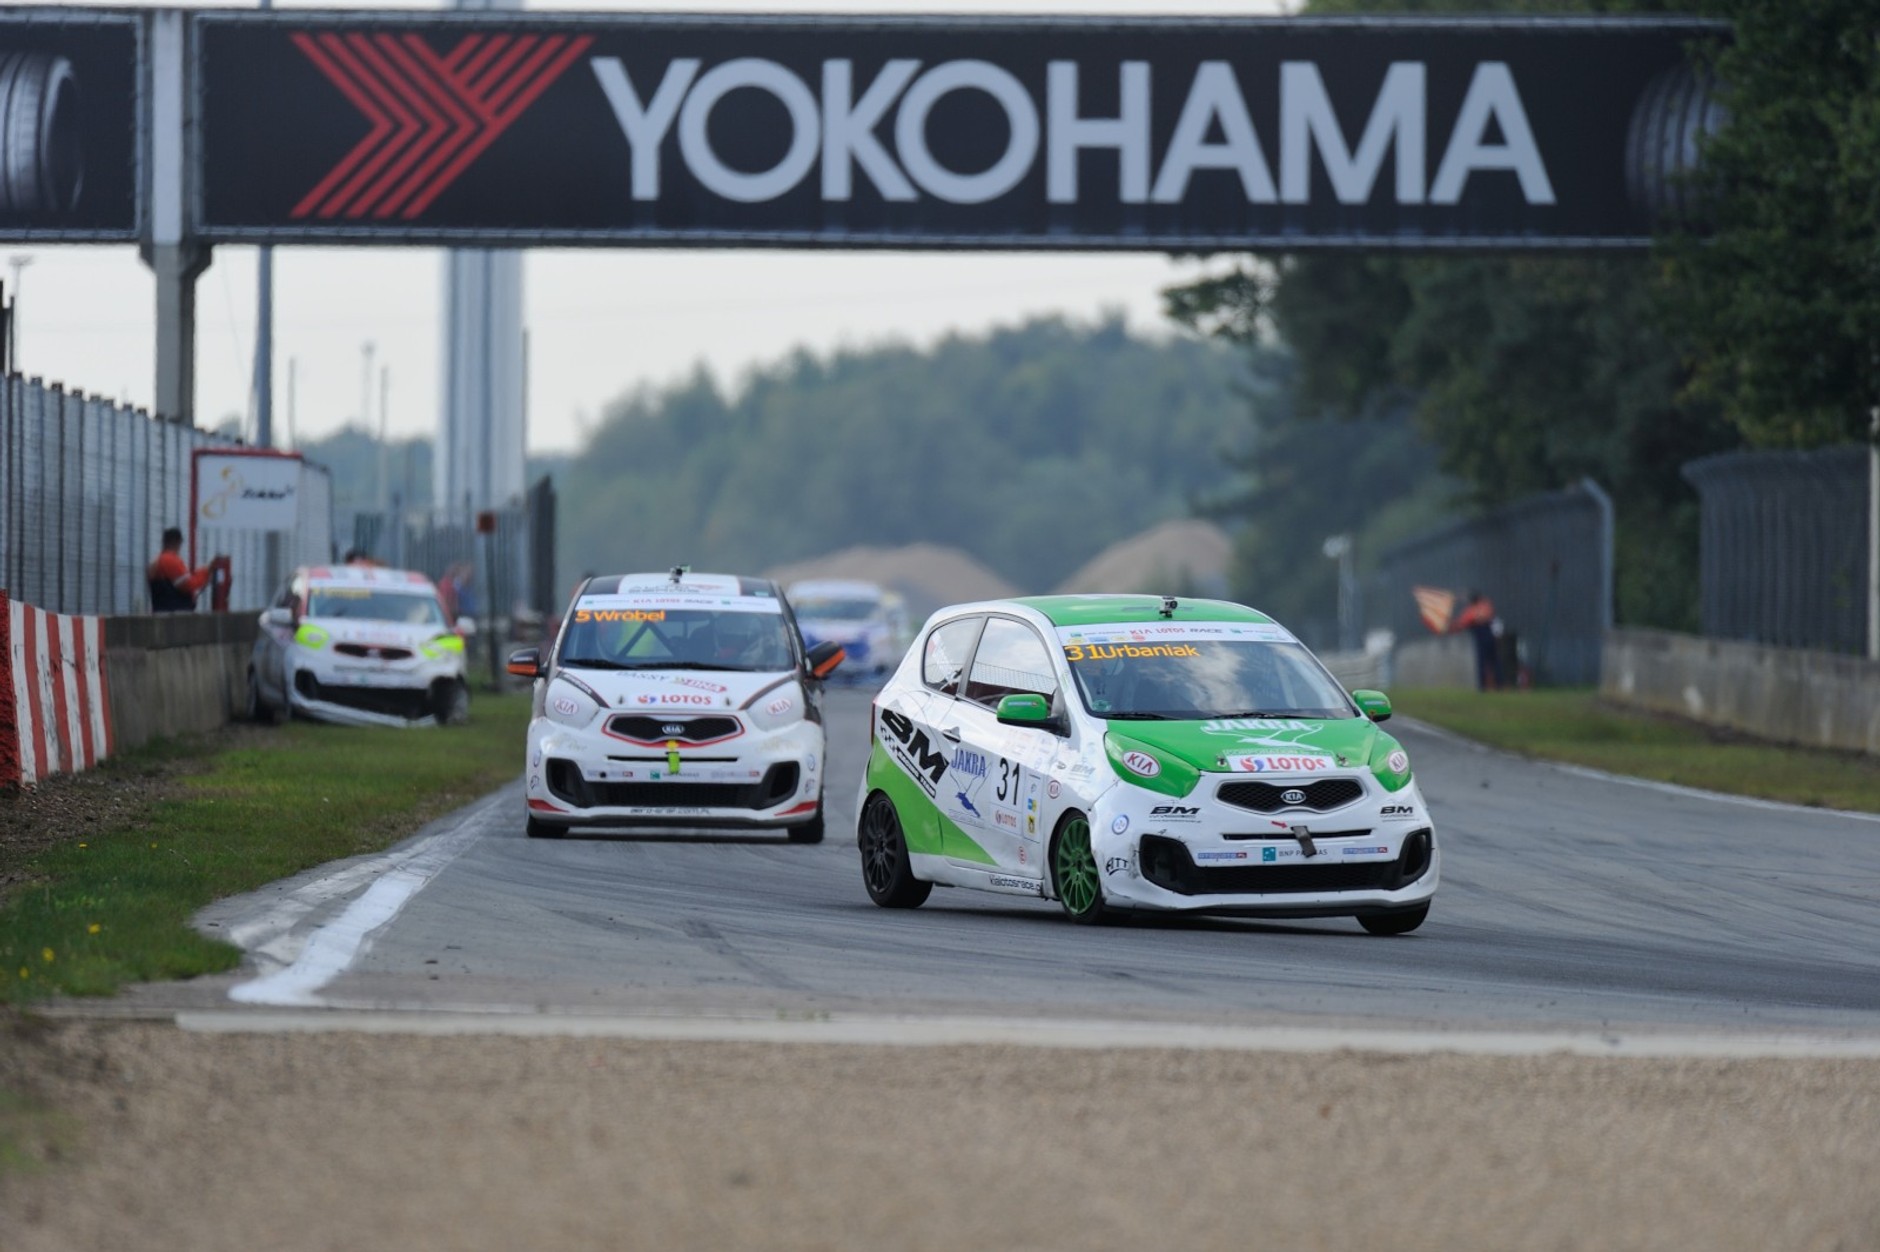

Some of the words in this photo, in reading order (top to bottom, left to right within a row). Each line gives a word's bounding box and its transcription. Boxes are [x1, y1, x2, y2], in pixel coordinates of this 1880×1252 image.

[590, 57, 1556, 204] YOKOHAMA
[660, 693, 712, 706] LOTOS
[880, 707, 950, 785] BM
[951, 748, 986, 778] JAKRA
[1126, 752, 1154, 774] KIA
[1265, 755, 1328, 771] LOTOS
[996, 756, 1020, 806] 31
[1149, 805, 1202, 815] BM
[1379, 805, 1415, 816] BM
